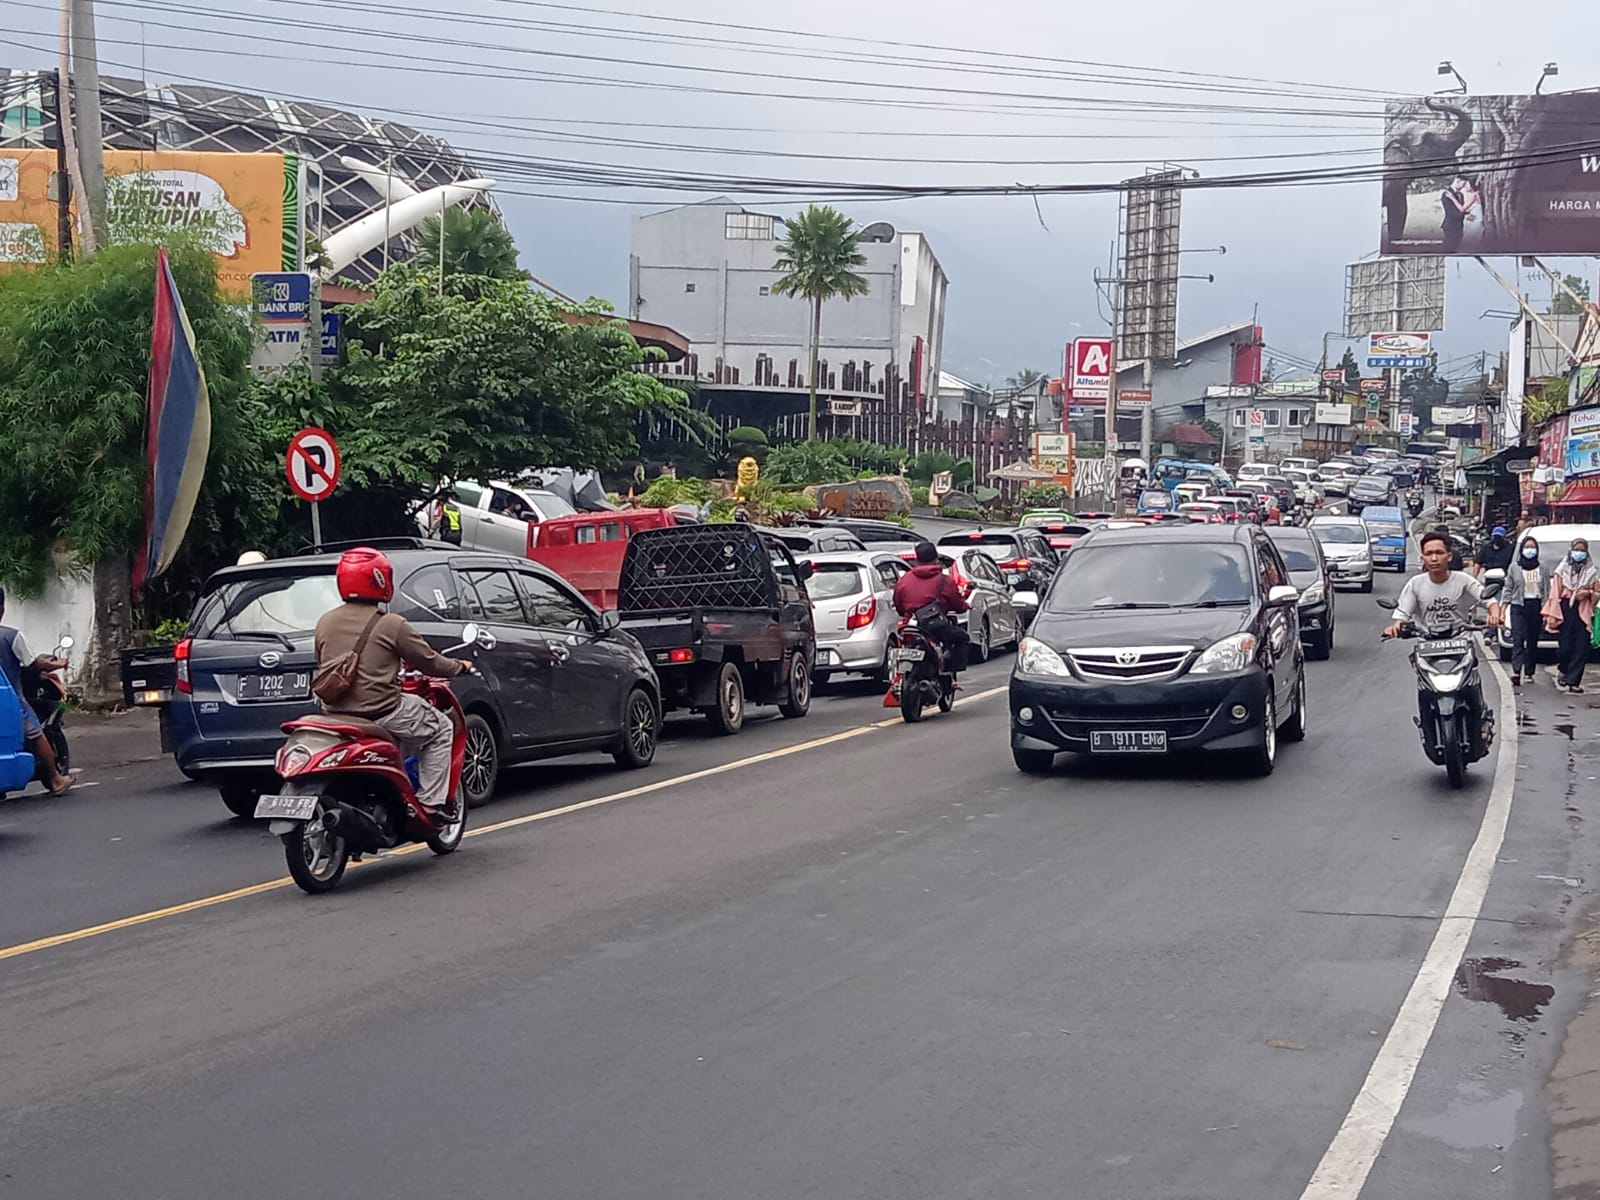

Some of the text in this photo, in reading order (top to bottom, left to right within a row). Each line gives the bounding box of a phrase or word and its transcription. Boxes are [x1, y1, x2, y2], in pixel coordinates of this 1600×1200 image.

[1550, 200, 1591, 210] HARGA
[259, 302, 305, 313] BANK BRI
[267, 330, 300, 343] ATM
[1077, 378, 1109, 386] Alfamid
[1572, 413, 1596, 423] Toko
[1433, 597, 1450, 606] NO
[1436, 611, 1451, 620] NO
[239, 677, 247, 692] F
[259, 675, 284, 690] 1202
[1093, 732, 1101, 746] B
[1111, 732, 1136, 746] 1911
